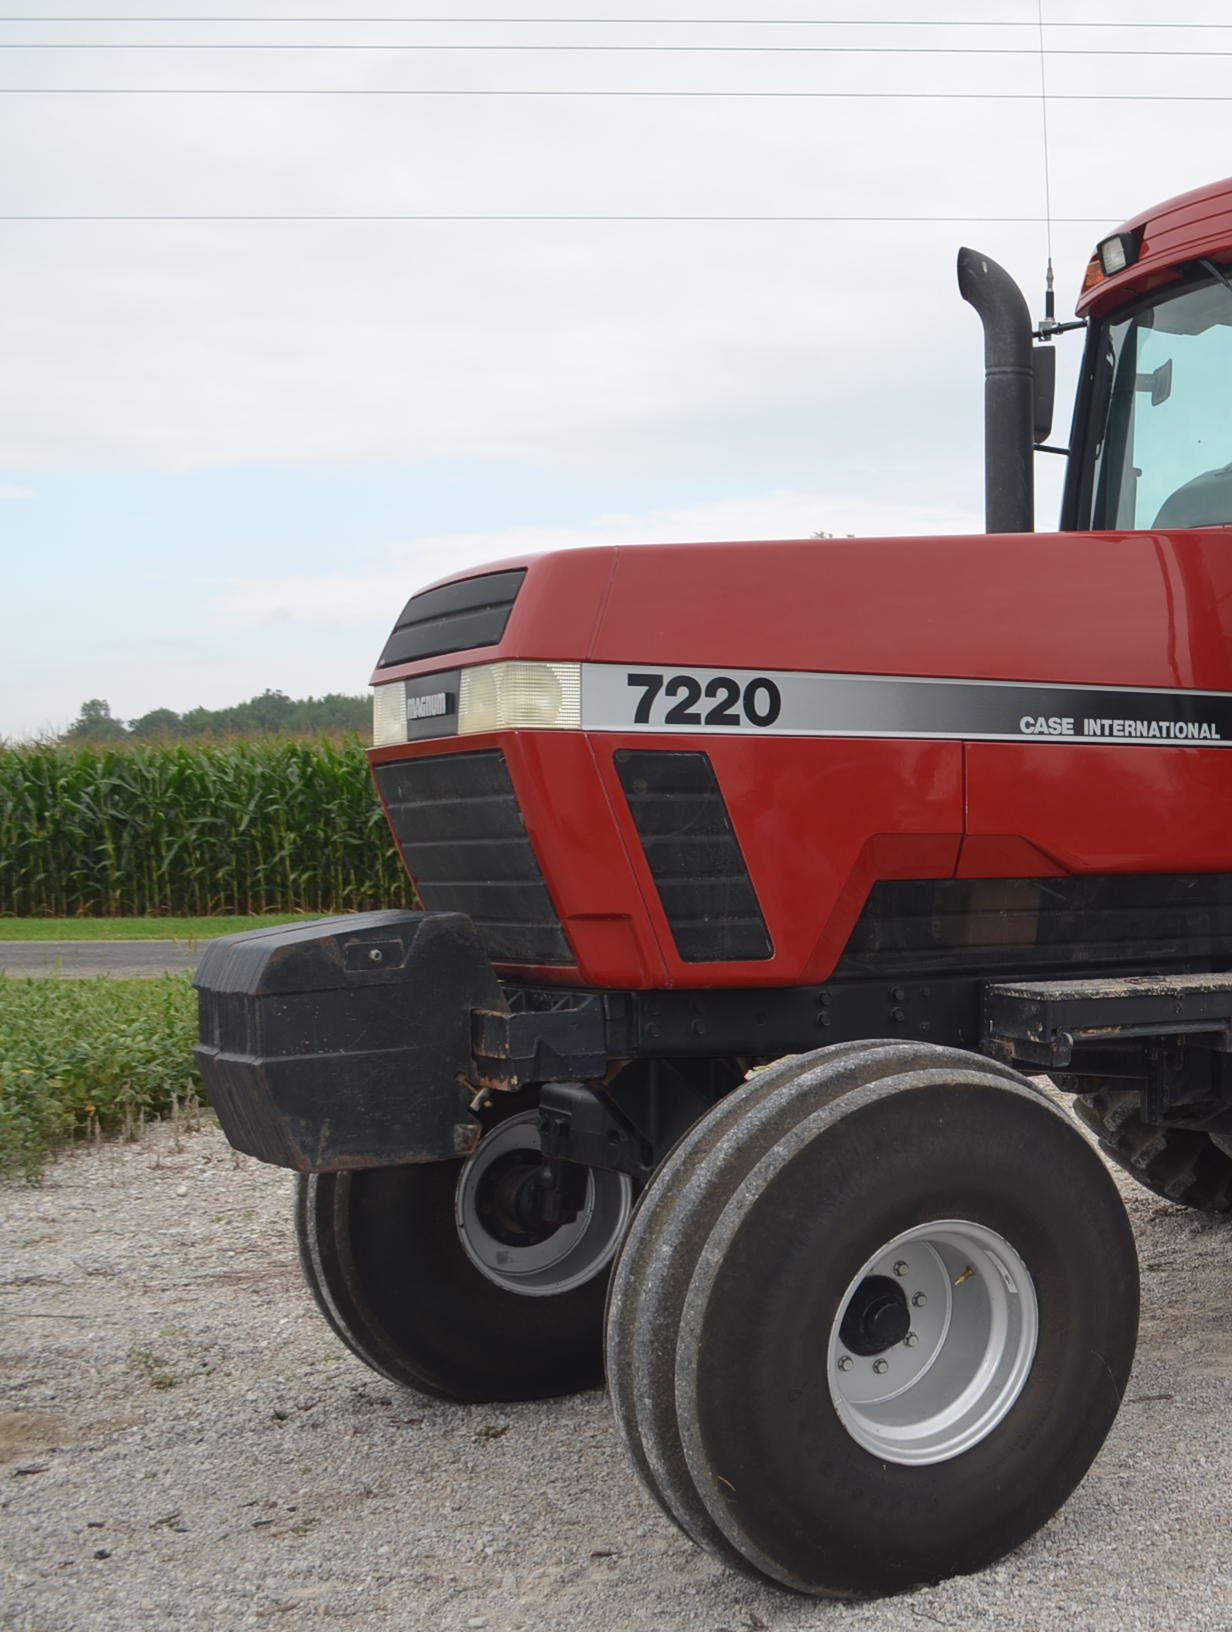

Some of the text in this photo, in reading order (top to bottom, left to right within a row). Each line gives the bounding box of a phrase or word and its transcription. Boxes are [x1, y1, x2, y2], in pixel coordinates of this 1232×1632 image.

[627, 673, 781, 727] 7220
[1019, 716, 1221, 739] CASE INTERNATIONAL
